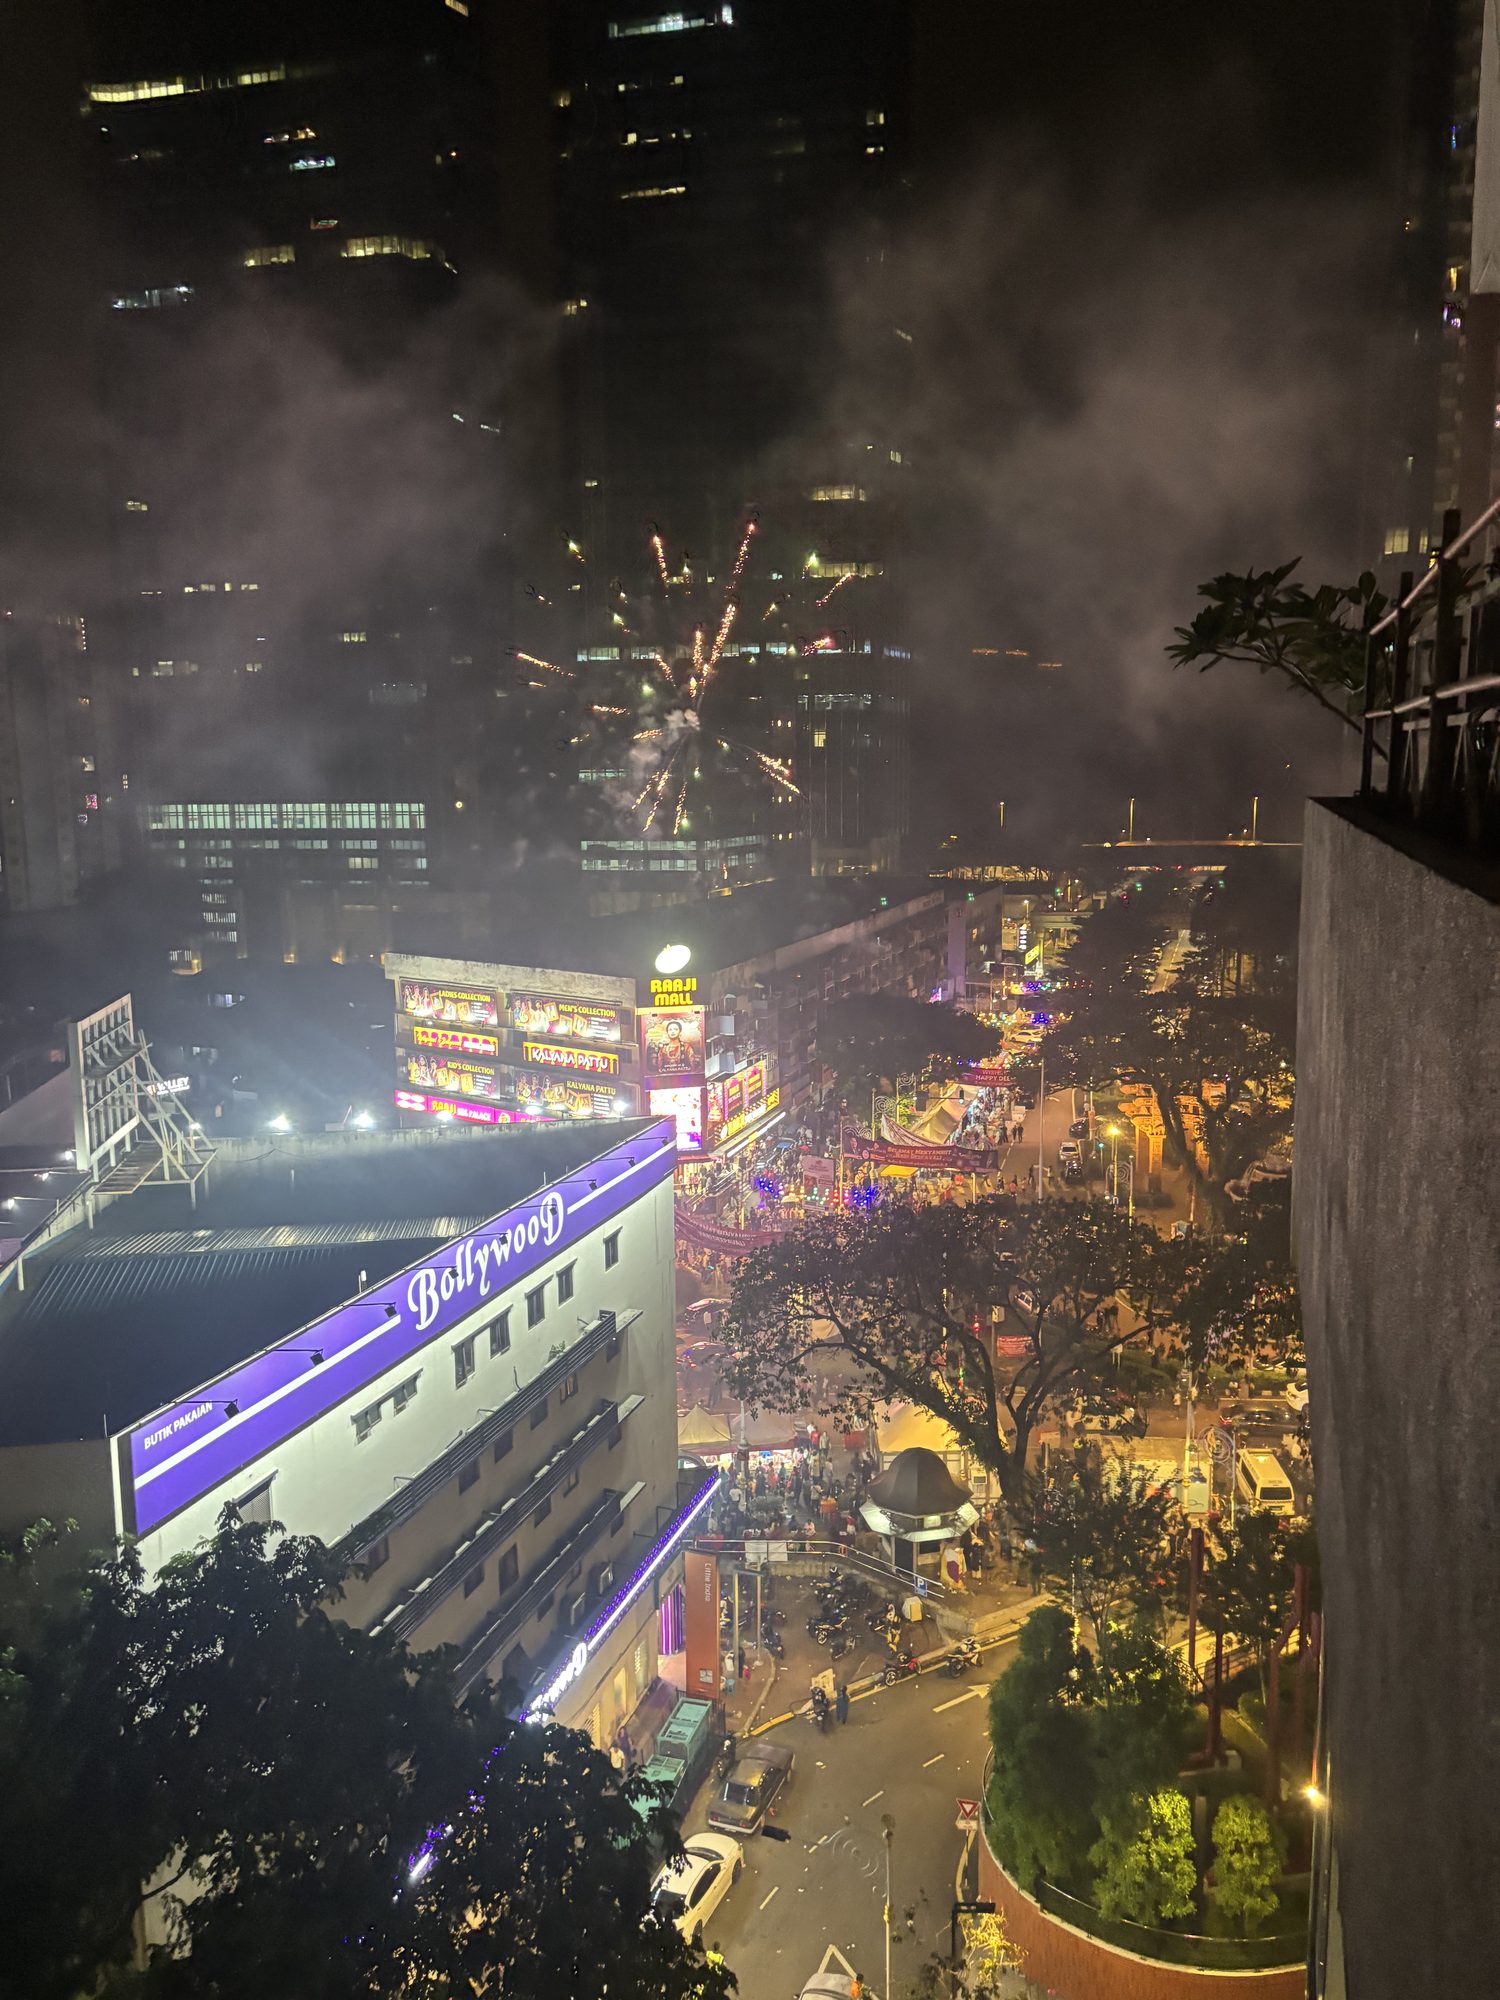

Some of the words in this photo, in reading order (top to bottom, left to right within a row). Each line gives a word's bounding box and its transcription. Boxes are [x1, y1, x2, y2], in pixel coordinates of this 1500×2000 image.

[651, 977, 697, 993] RAAJI
[439, 990, 457, 999] LADIES
[457, 992, 491, 1003] COLLECTION
[655, 992, 693, 1006] MALL
[559, 1003, 577, 1013] MEN'S
[578, 1006, 616, 1018] COLLECTION
[532, 1047, 575, 1064] KALYANA
[578, 1054, 609, 1069] PATTU
[447, 1061, 461, 1071] KID'S
[462, 1064, 495, 1075] COLLECTION
[566, 1080, 595, 1092] KALYANA
[596, 1084, 617, 1095] PATTU
[144, 1423, 173, 1450] BUTIK
[173, 1400, 213, 1433] PAKAIAN
